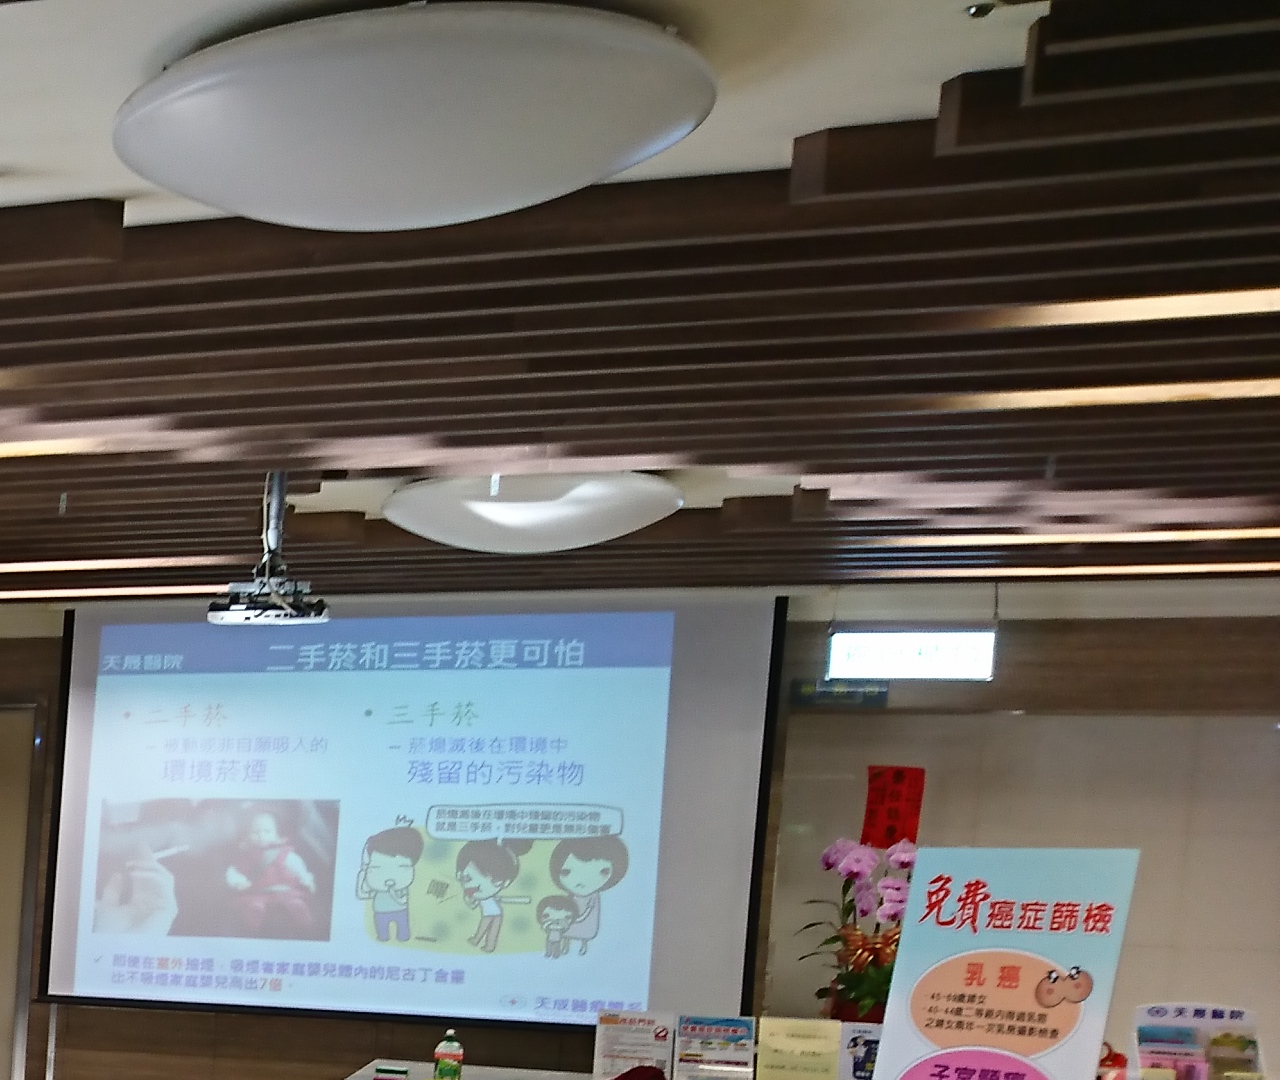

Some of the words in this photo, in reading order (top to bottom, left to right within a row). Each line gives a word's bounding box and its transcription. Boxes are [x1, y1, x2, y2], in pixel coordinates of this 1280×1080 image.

[267, 638, 585, 672] 二手菸和三手菸更可怕
[386, 700, 479, 727] 三手菸
[407, 759, 585, 786] 殘留的污染物
